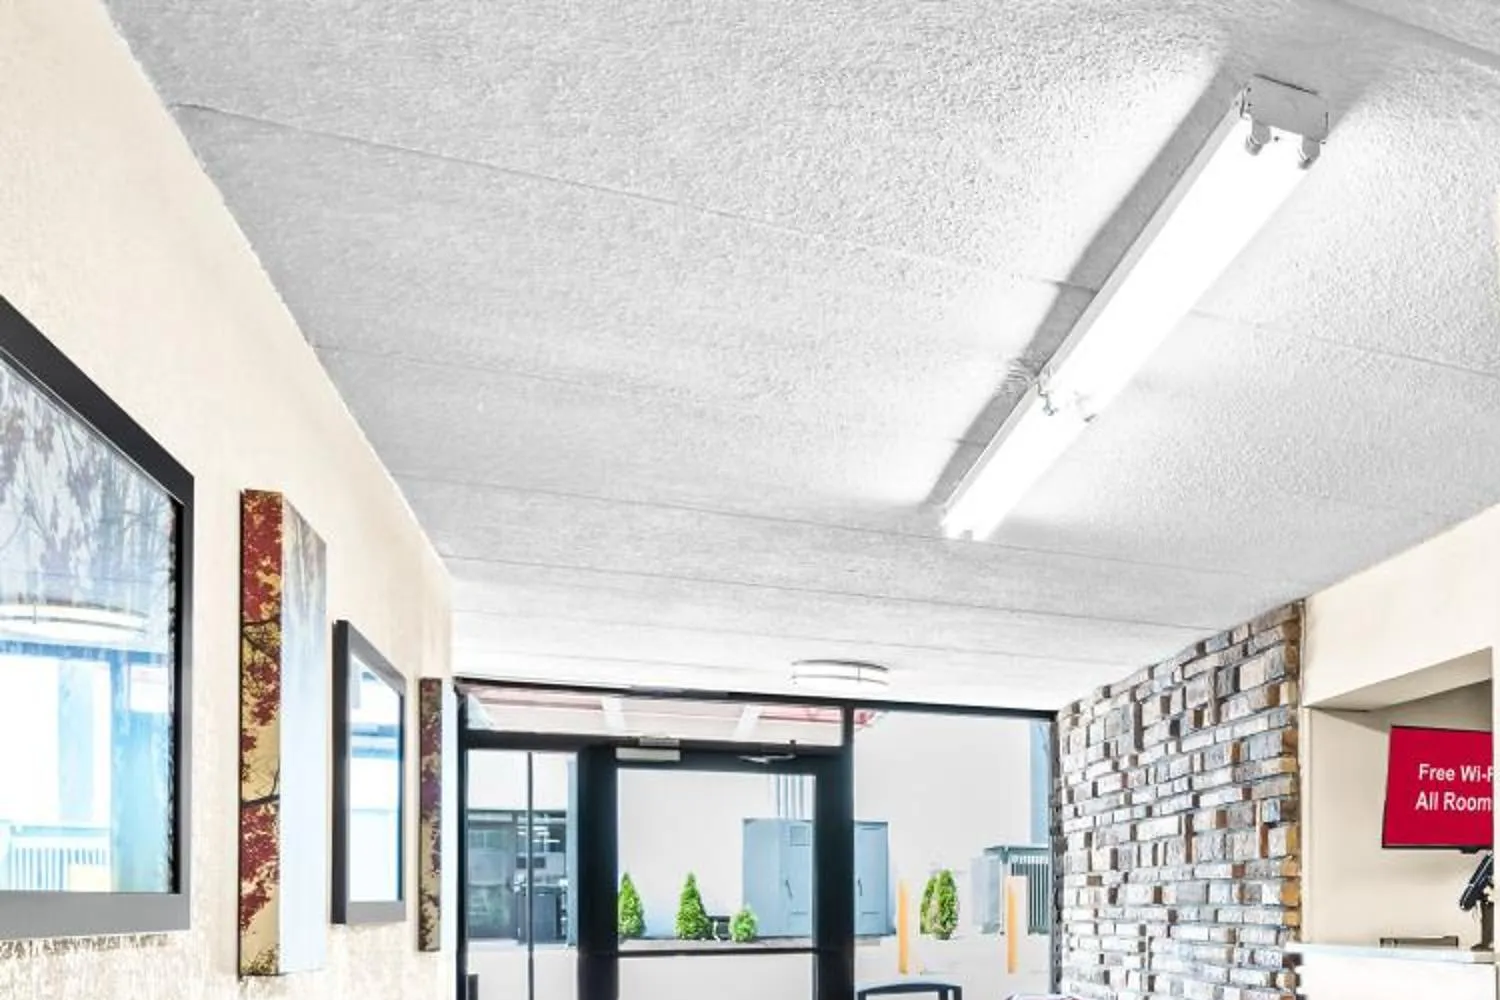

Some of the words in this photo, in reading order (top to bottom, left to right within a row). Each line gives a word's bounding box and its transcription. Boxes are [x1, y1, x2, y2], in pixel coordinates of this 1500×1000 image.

[1419, 763, 1455, 781] Free
[1415, 791, 1439, 811] All
[1444, 791, 1492, 812] Room
